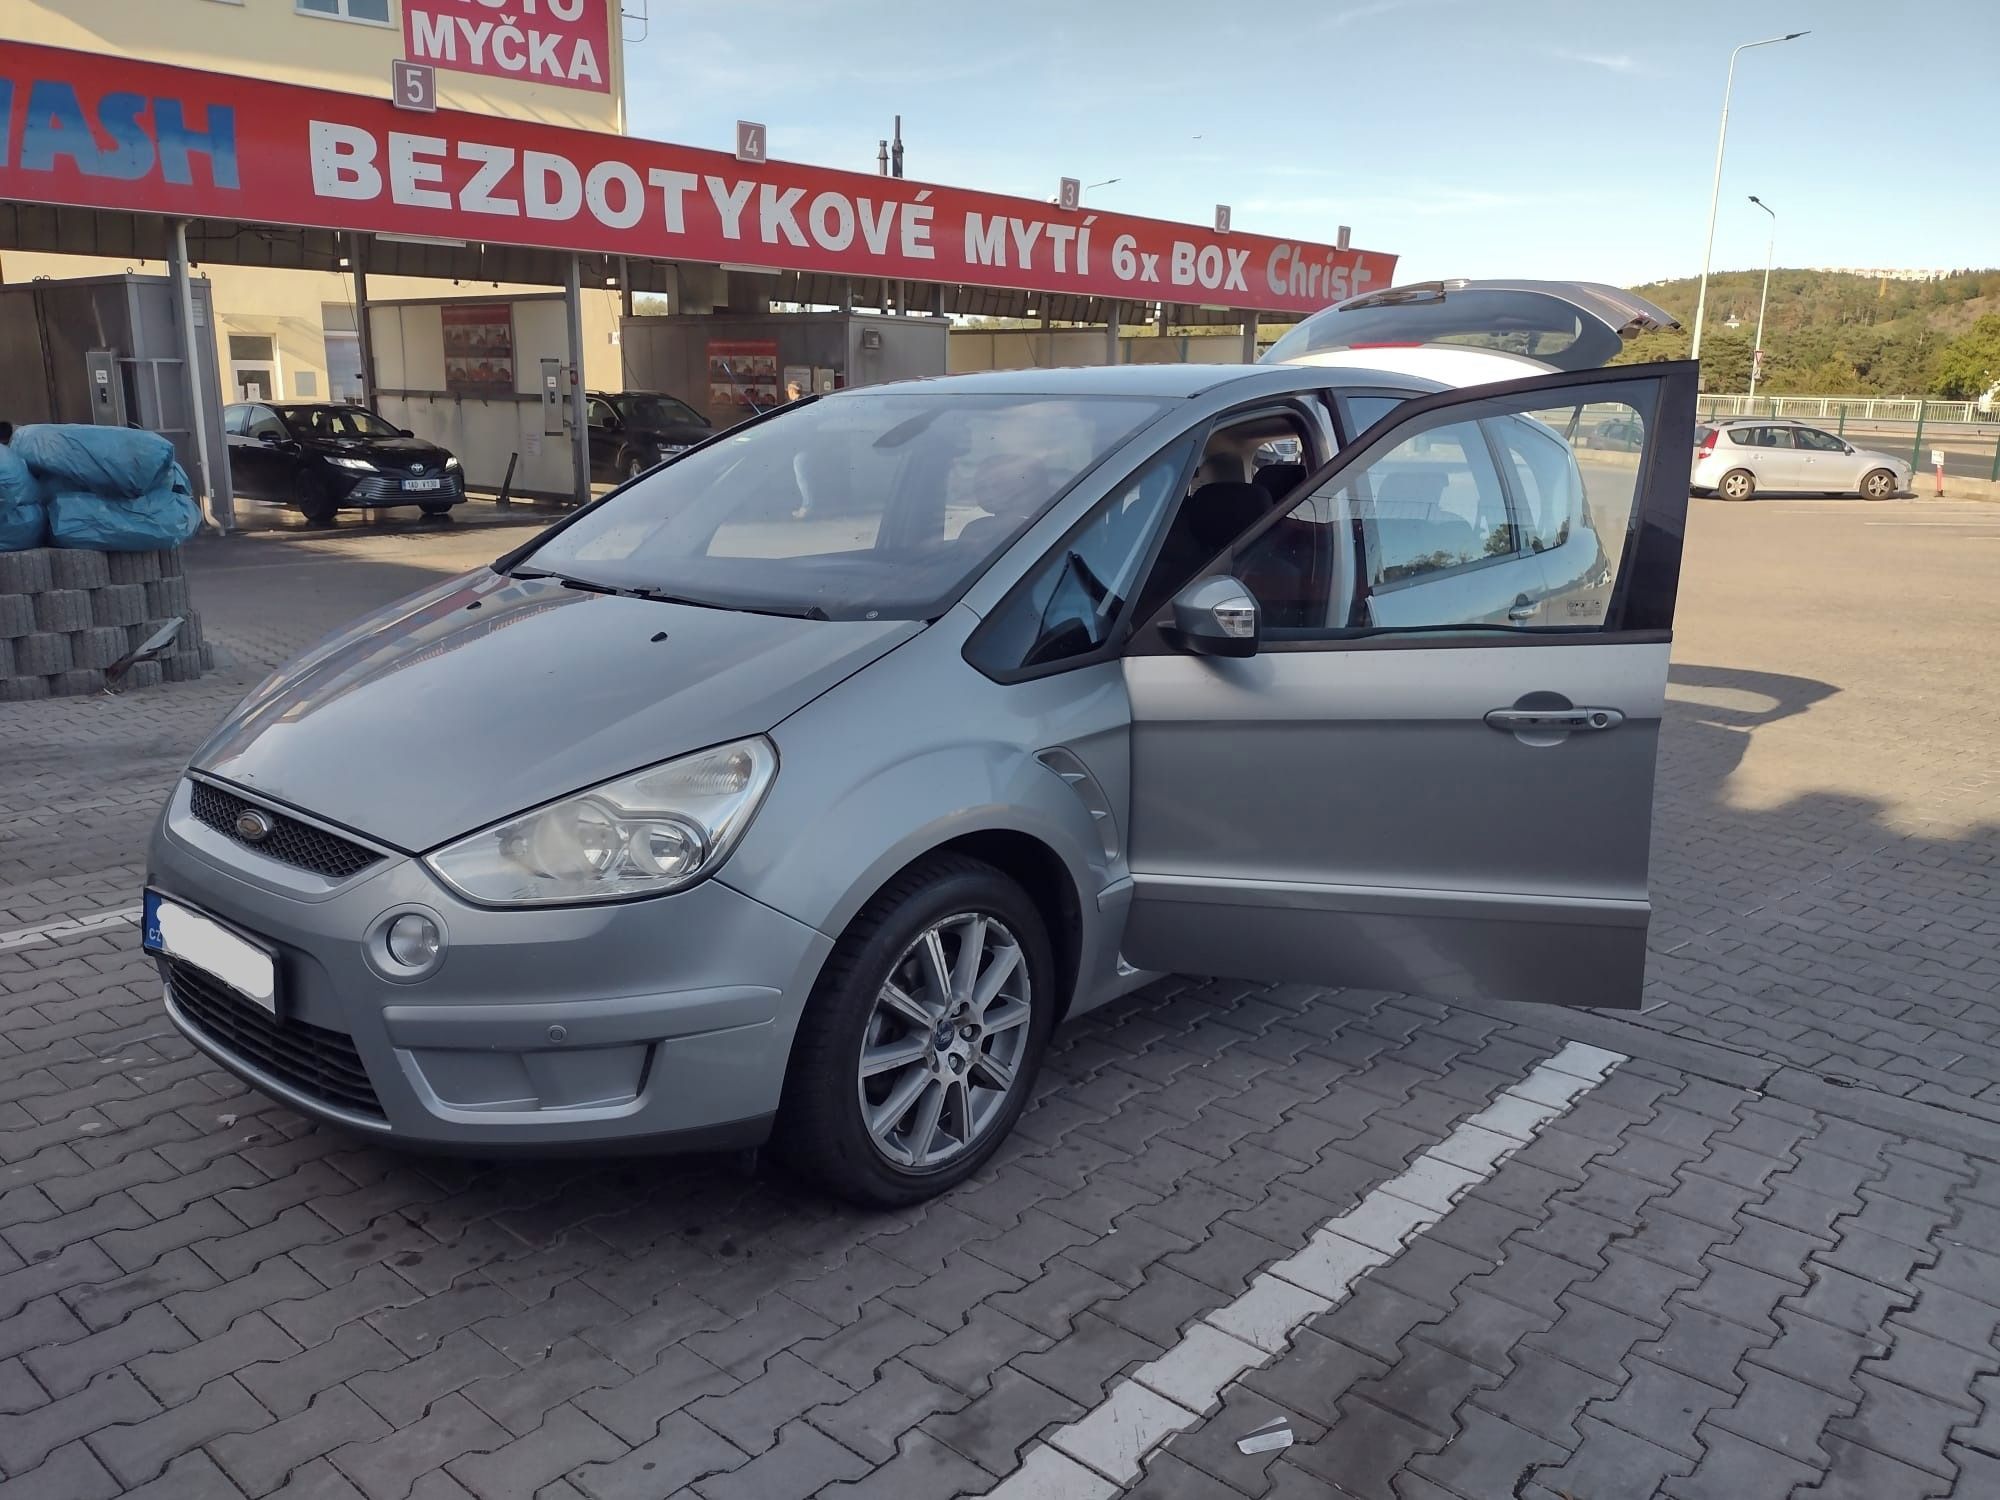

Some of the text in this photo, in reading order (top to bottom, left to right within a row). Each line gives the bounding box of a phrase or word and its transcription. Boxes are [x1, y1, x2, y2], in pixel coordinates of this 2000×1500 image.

[411, 10, 602, 84] MYČKA
[406, 69, 424, 103] 5
[0, 75, 240, 190] ASH
[745, 129, 759, 158] 4
[308, 119, 1372, 300] BEZDOTYKOVÉ MYTÍ 6x BOX Christ
[1065, 183, 1075, 206] 3
[1219, 209, 1227, 230] 2
[149, 927, 162, 942] CZ
